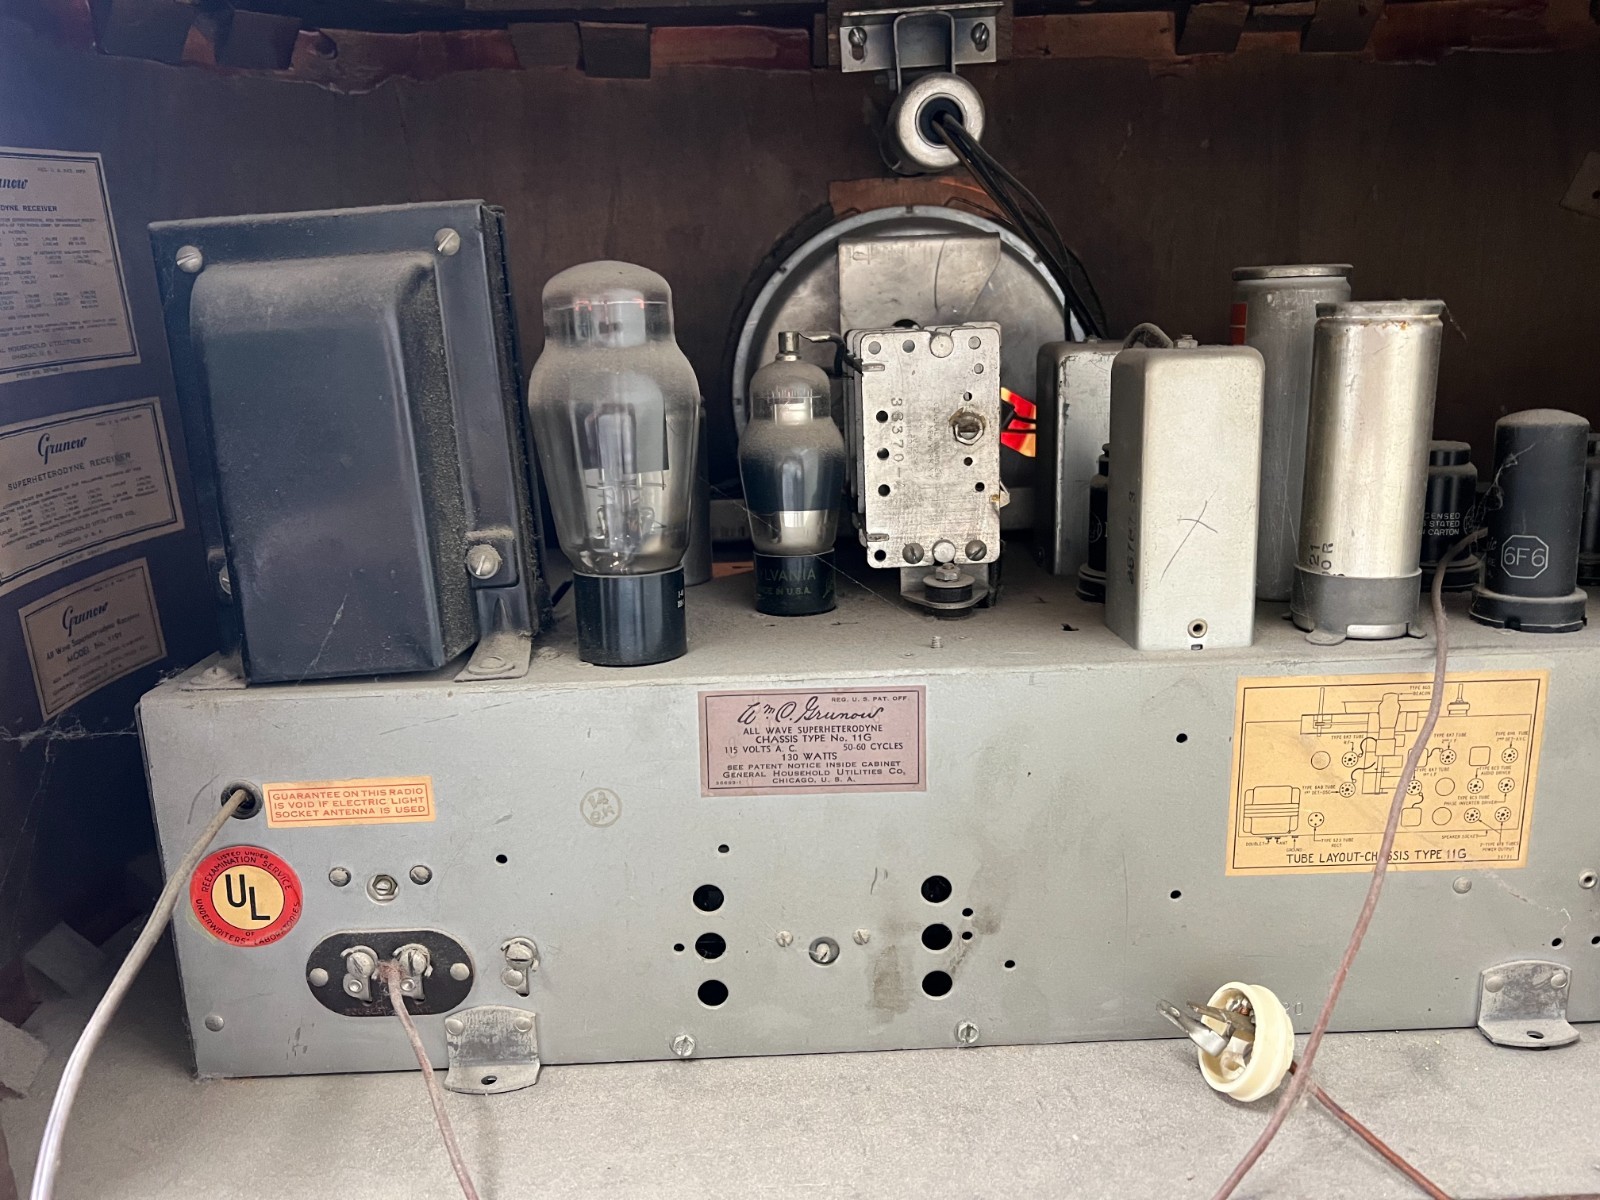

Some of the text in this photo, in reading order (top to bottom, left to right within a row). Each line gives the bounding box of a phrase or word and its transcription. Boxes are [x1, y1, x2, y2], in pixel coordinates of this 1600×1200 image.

[38, 432, 88, 464] Grunow
[8, 462, 85, 490] SUPERHETERODYNE
[1504, 546, 1546, 568] 6F6
[62, 602, 108, 637] Grunow
[794, 696, 884, 724] Grunow
[743, 724, 884, 735] ALL WAVE SUPERHETERODYNE
[755, 733, 872, 744] CHASSIS TYPE No. 11G
[870, 742, 904, 750] CYCLES
[782, 752, 838, 761] 130 WATTS
[272, 788, 424, 800] GUARANTEE ON THIS RADIO
[332, 799, 386, 807] ELECTRIC
[391, 796, 425, 804] LIGHT
[275, 810, 320, 818] SOCKET
[322, 808, 376, 816] ANTENNA
[396, 806, 426, 814] USED
[216, 850, 269, 860] LISTED UNDER
[1286, 848, 1467, 864] TUBE LAYOUT-CHSSIS TYPE 11G
[202, 856, 292, 892] REEXAMINATION SERVICE
[225, 874, 270, 920] UL
